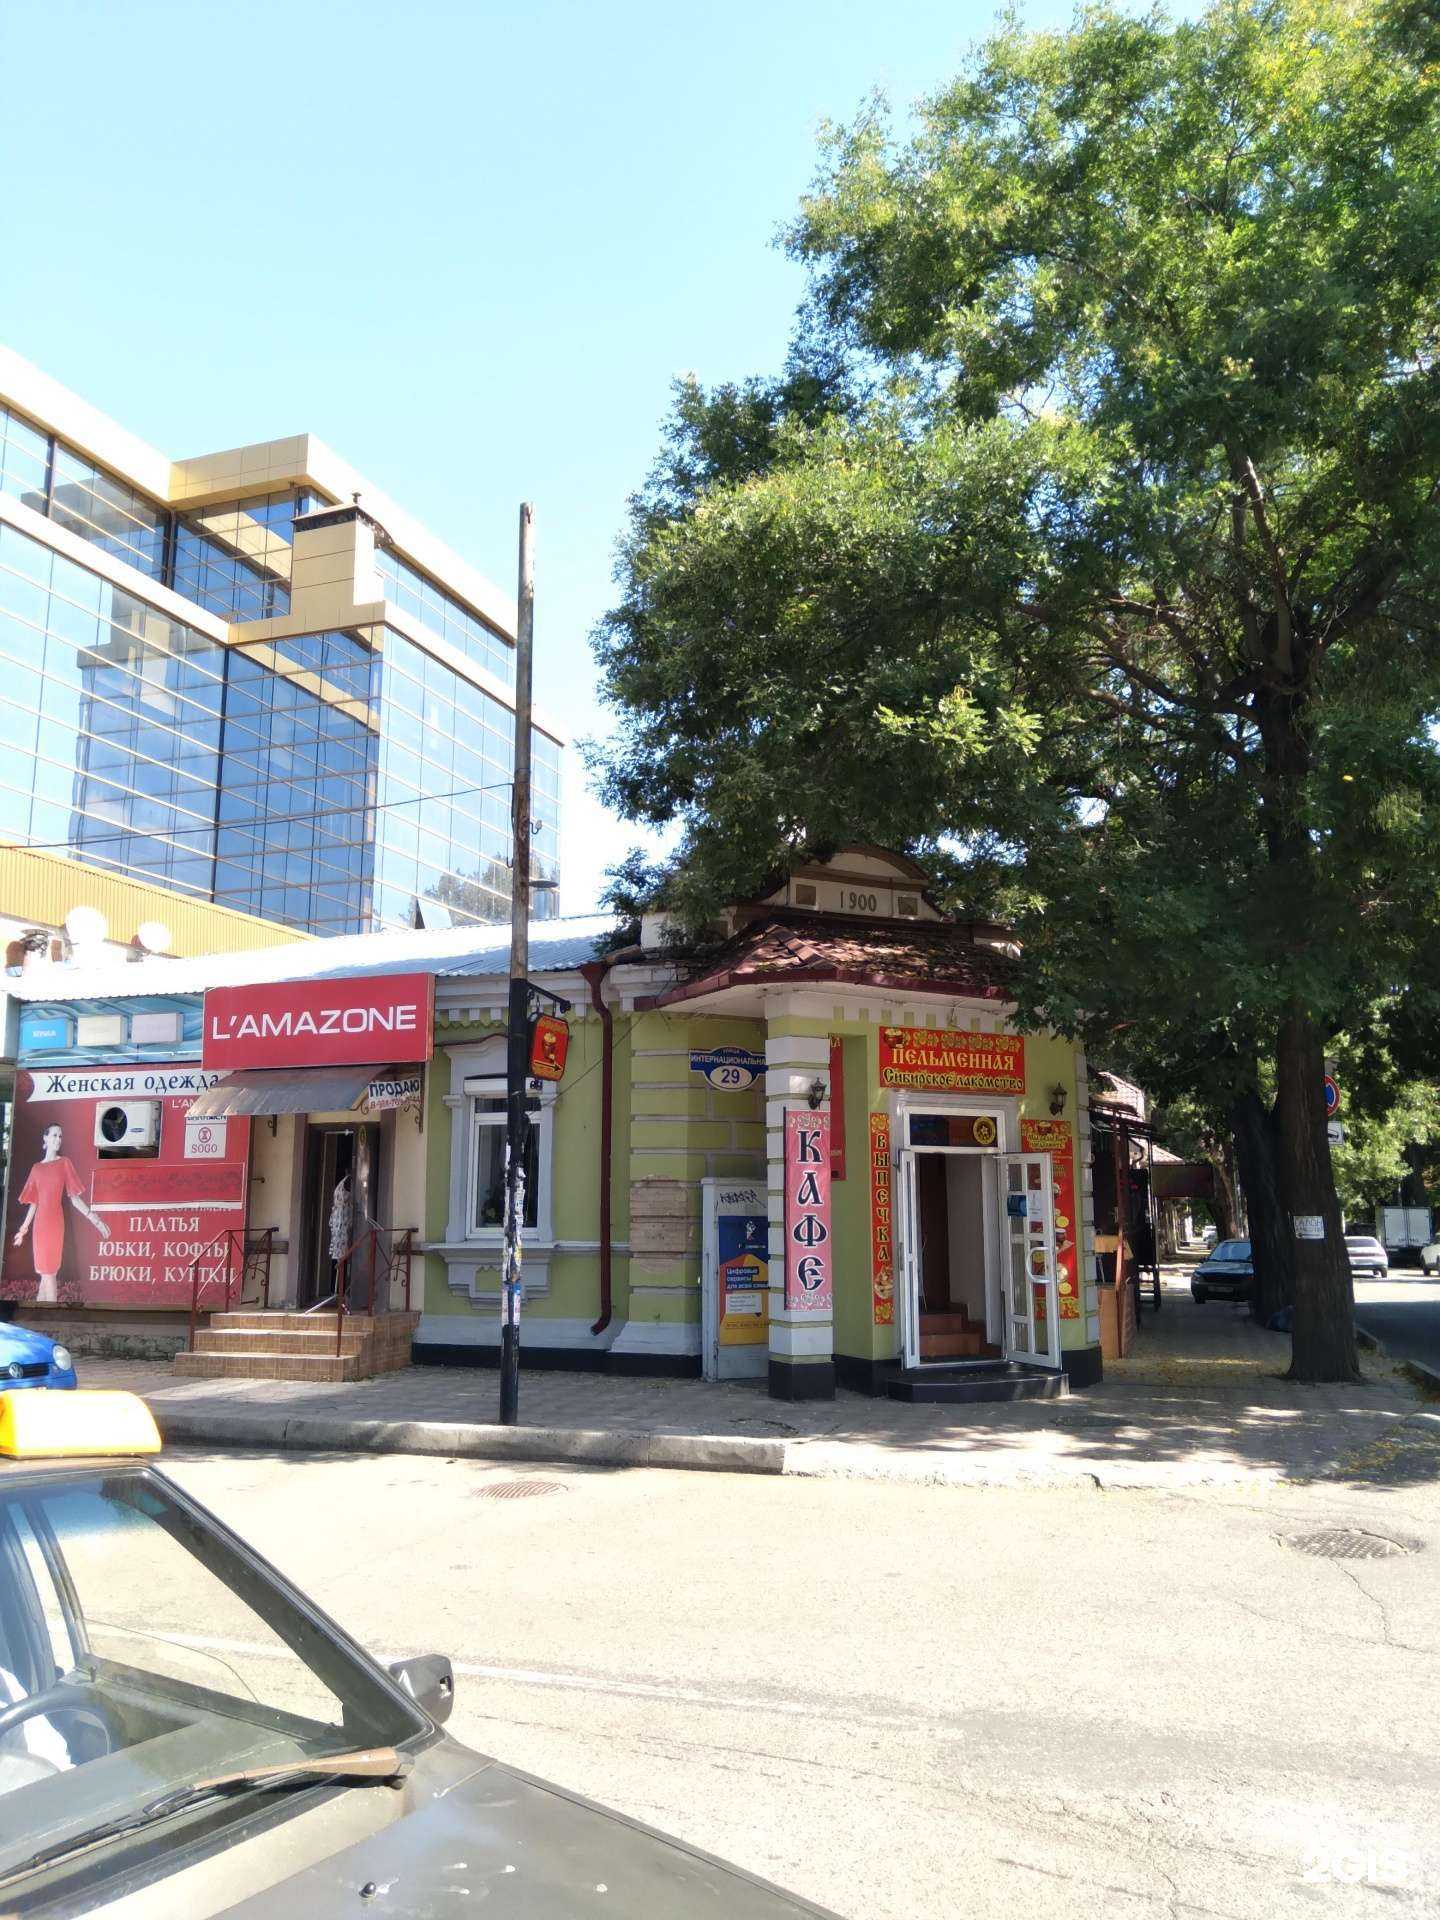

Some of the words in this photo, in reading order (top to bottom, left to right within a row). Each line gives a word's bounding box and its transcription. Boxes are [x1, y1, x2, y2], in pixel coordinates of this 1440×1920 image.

[840, 891, 877, 912] 1900
[212, 1005, 417, 1040] L'AMAZONE
[690, 1055, 767, 1065] ИНТЕРНАЦИОНАЛЬНА
[46, 1075, 135, 1093] Женская
[144, 1074, 219, 1094] одежда
[721, 1069, 740, 1084] 29
[369, 1080, 420, 1097] ПРОДАЮ
[874, 1134, 889, 1261] ВЫПЕЧКА
[793, 1130, 827, 1291] КАФЕ
[129, 1217, 200, 1232] ПЛАТЬЯ
[97, 1241, 156, 1260] ЮБКИ,
[163, 1241, 229, 1257] КОФТЫ
[89, 1265, 156, 1283] БРЮКИ,
